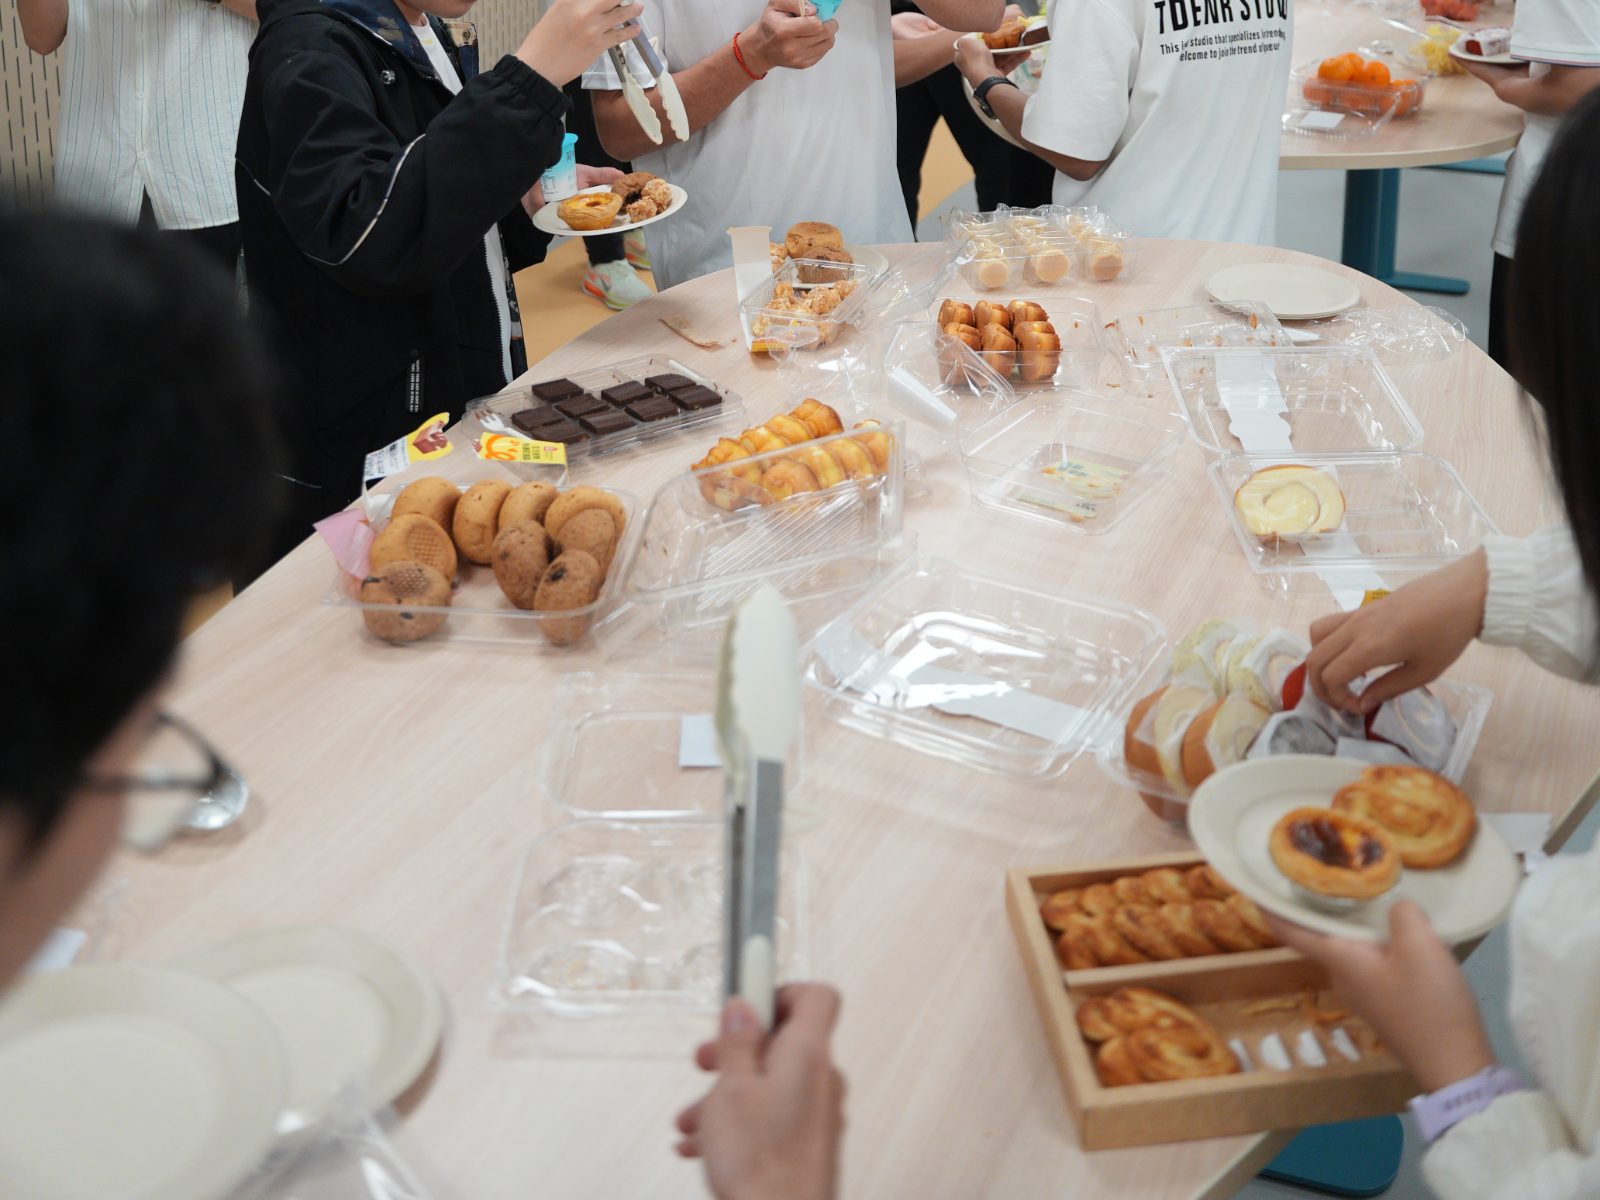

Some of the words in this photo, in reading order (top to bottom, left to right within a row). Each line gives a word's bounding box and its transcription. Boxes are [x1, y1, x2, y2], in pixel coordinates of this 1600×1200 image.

[1160, 43, 1180, 55] This
[1190, 35, 1213, 47] studio
[1214, 33, 1228, 45] that
[1179, 50, 1208, 61] elcome
[1209, 49, 1218, 58] to
[1237, 43, 1257, 55] trend
